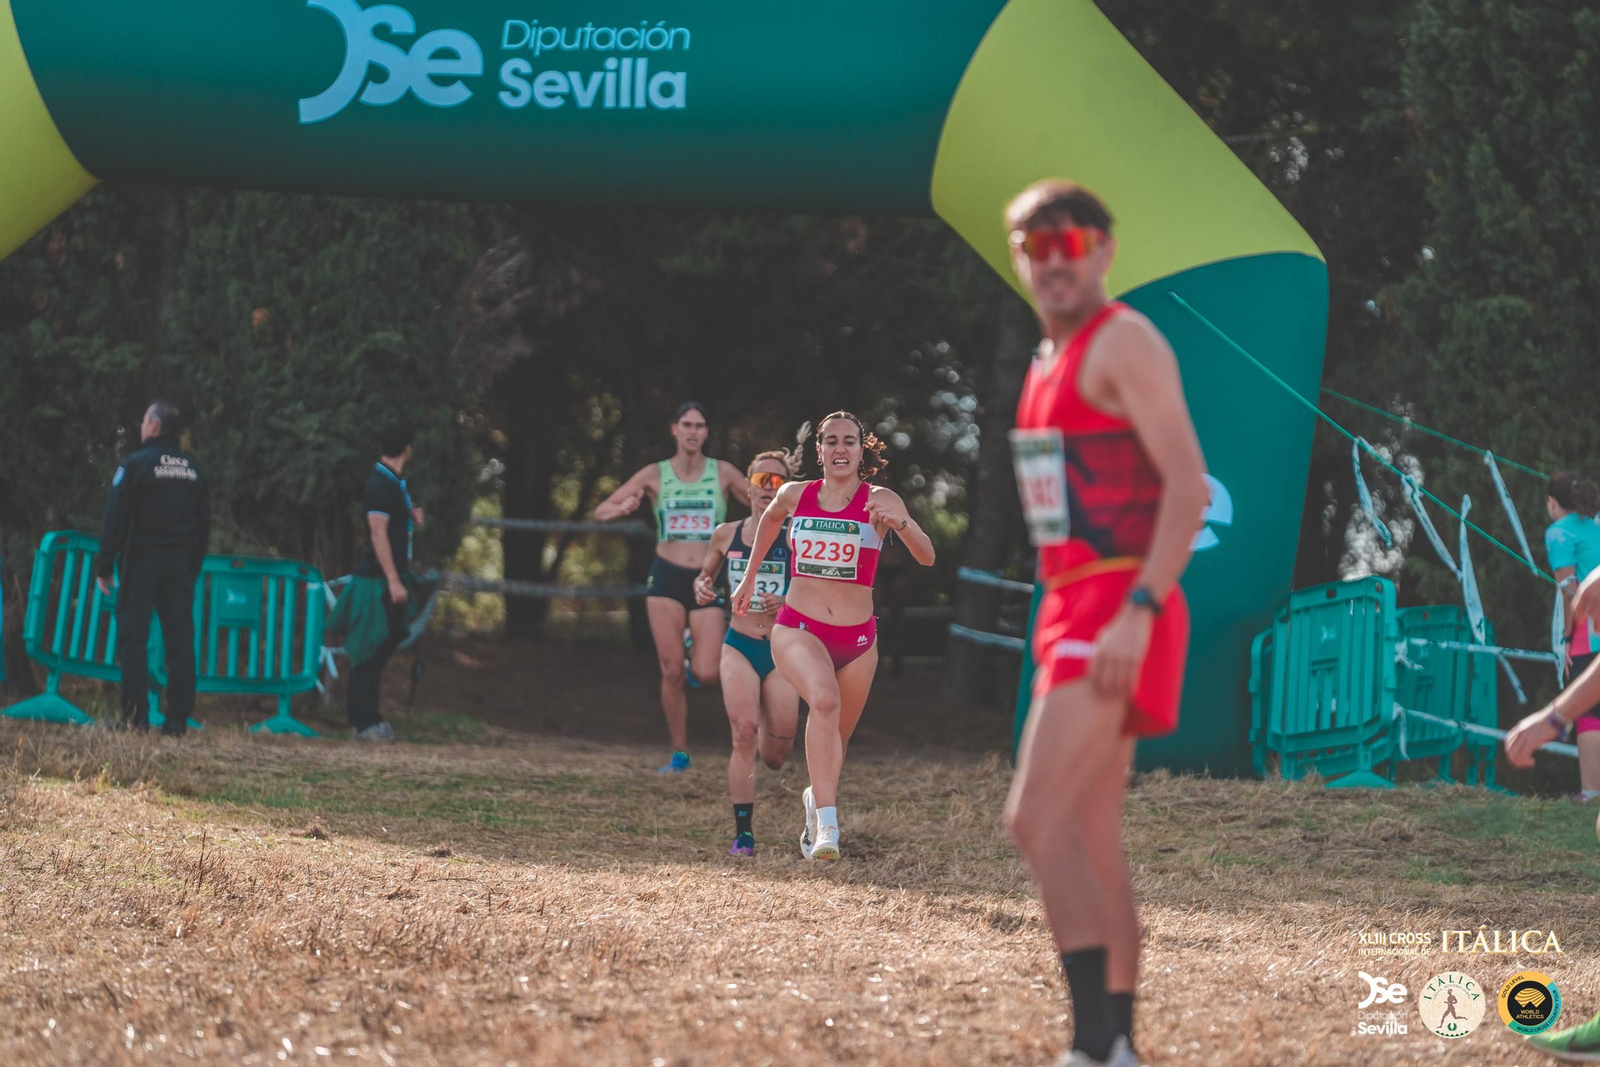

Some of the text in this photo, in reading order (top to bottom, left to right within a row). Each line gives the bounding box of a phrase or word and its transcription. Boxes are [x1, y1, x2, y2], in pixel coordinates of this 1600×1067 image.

[503, 19, 691, 56] Diputación
[499, 57, 687, 108] Sevilla
[669, 515, 711, 531] 2253
[801, 539, 855, 562] 2239
